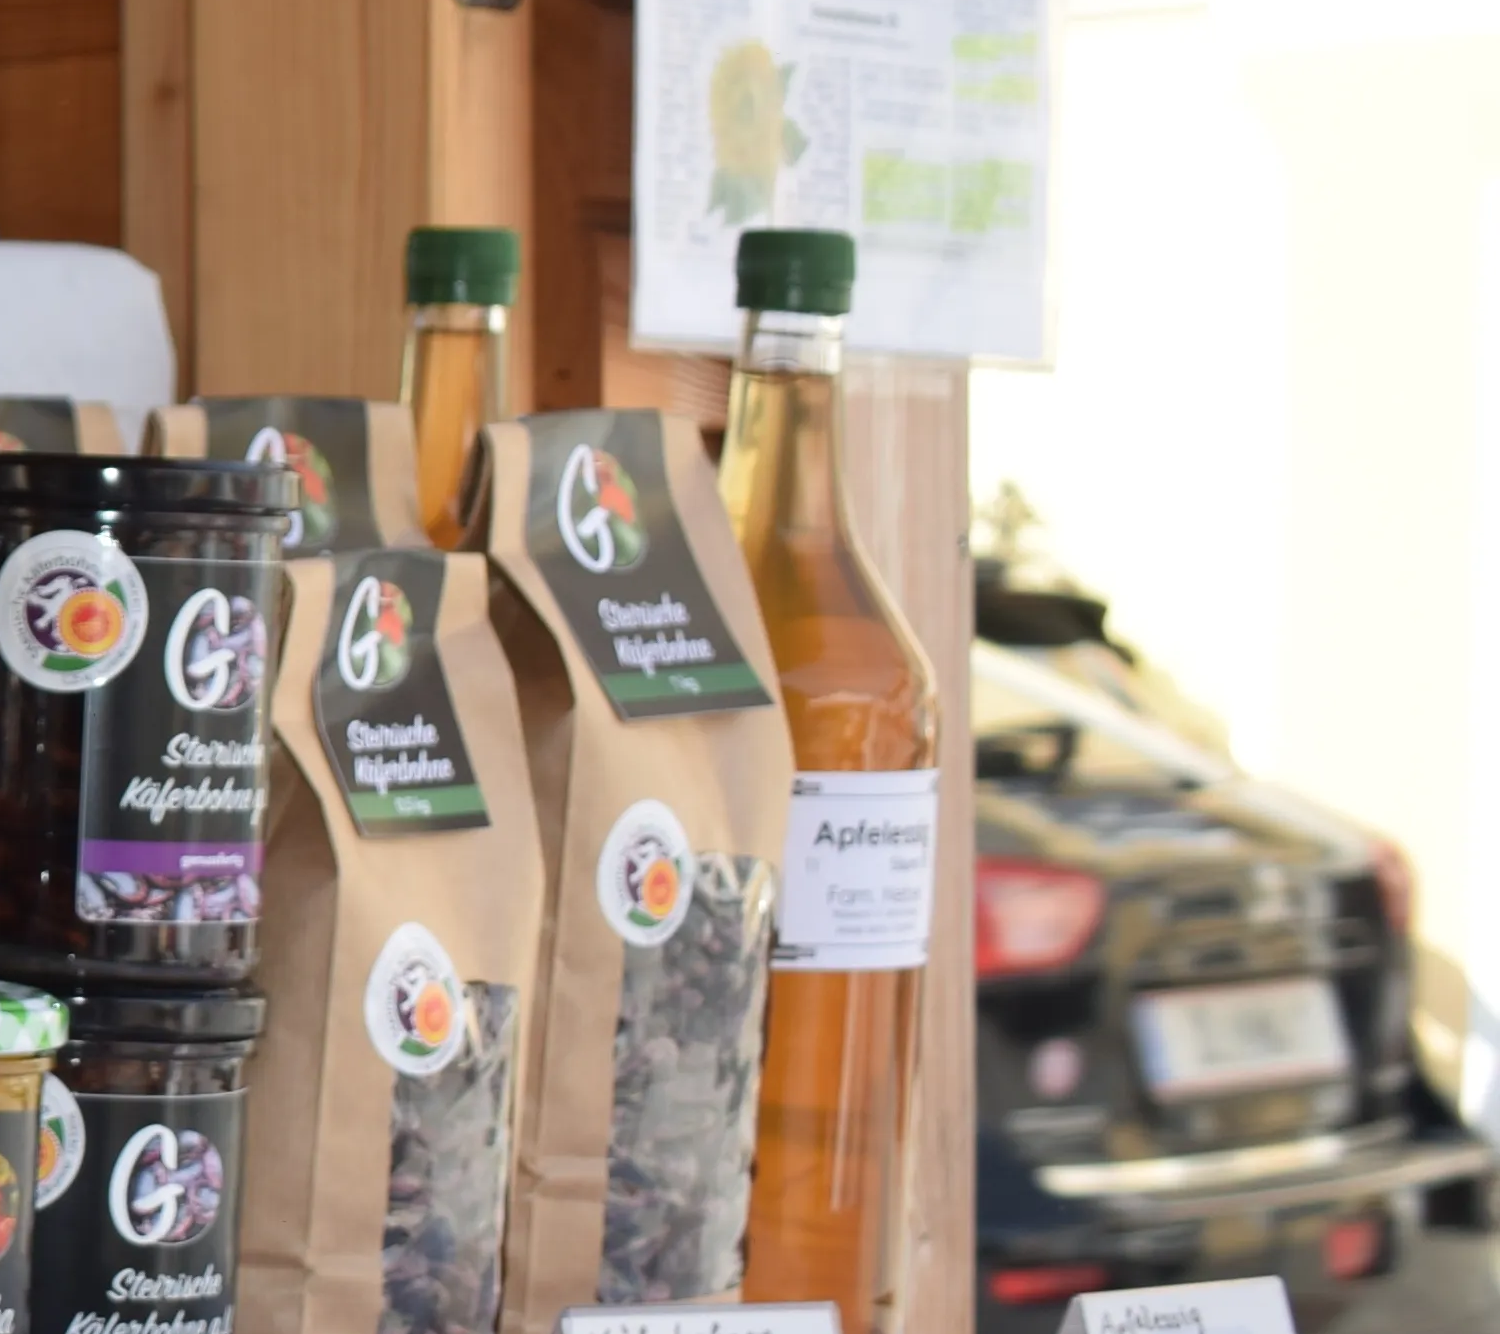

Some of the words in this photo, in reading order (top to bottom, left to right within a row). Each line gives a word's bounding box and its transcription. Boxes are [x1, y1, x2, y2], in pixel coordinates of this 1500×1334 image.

[557, 444, 615, 572] G
[165, 587, 236, 711] G
[338, 575, 383, 691] G
[109, 1123, 185, 1244] G
